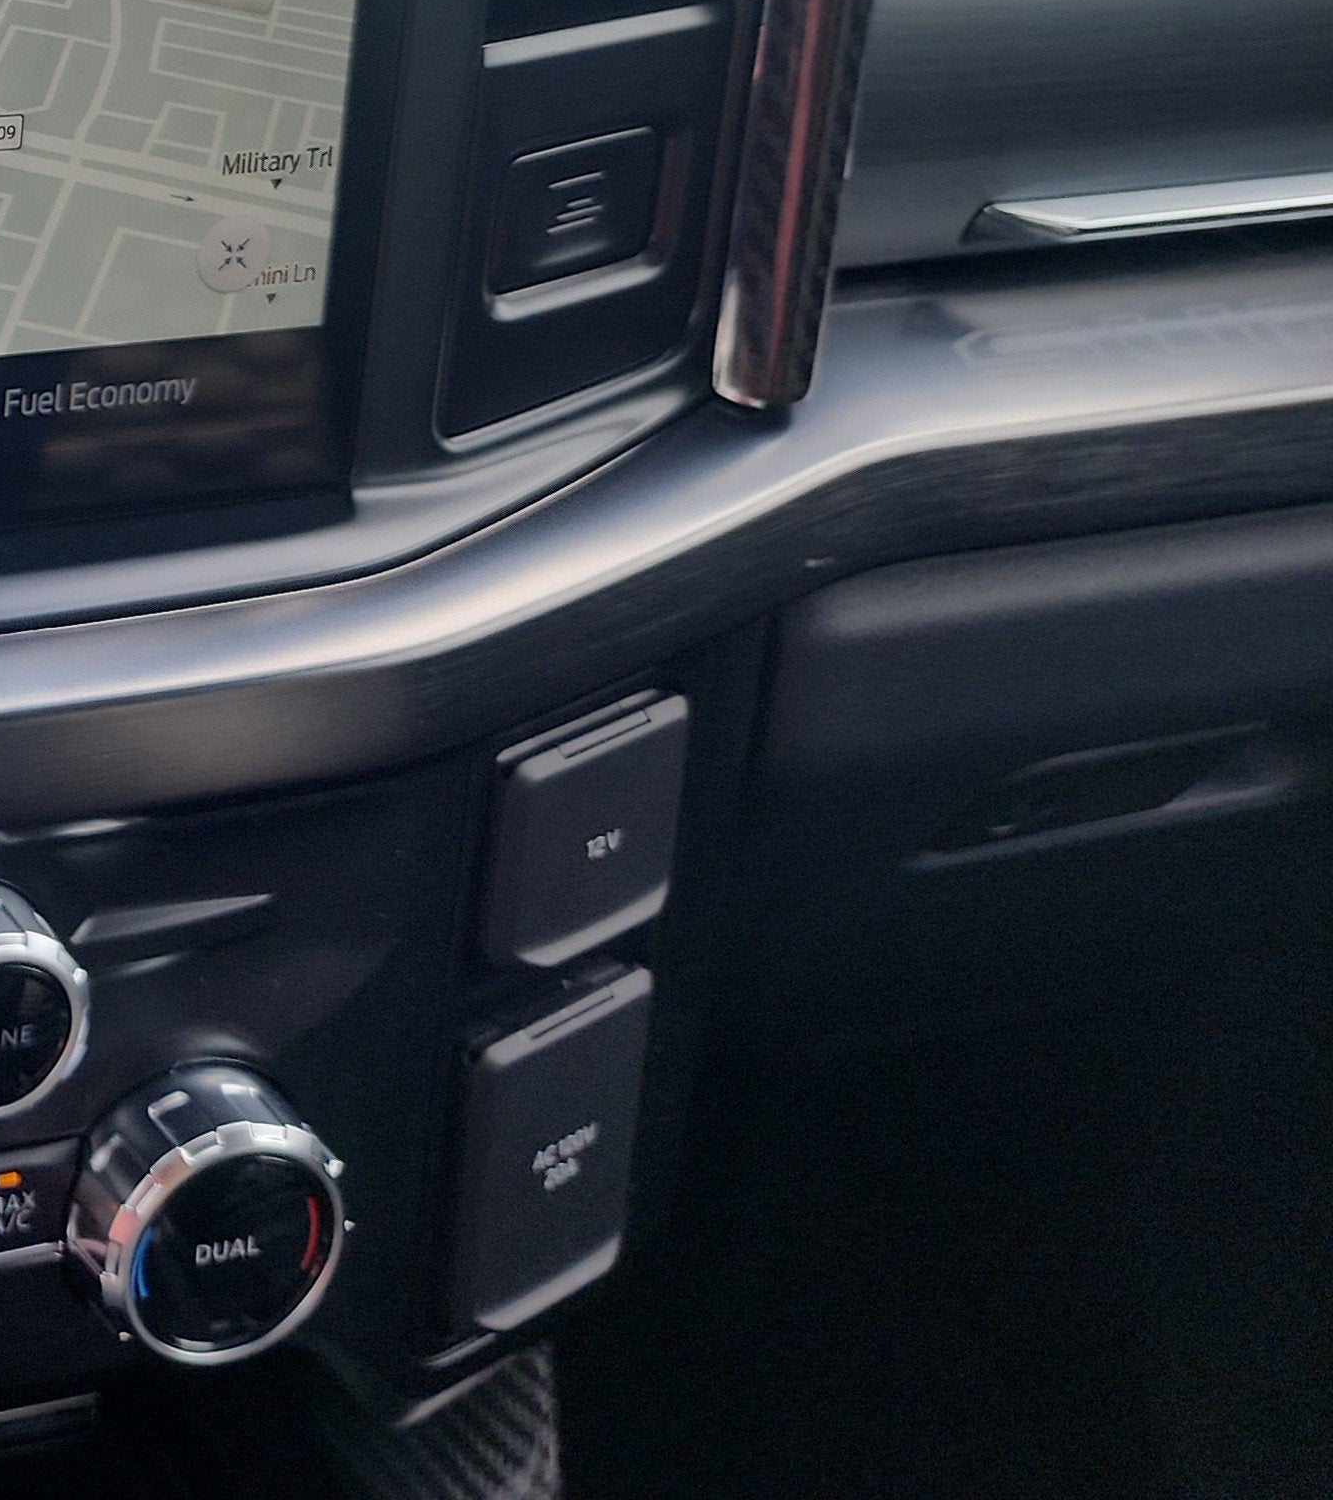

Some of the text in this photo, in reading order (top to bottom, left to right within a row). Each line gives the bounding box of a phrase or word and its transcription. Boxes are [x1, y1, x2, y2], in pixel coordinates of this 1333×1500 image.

[221, 145, 333, 176] Military Trl
[293, 263, 317, 284] Ln
[2, 376, 198, 418] Fuel Economy
[193, 1235, 262, 1264] DUAL
